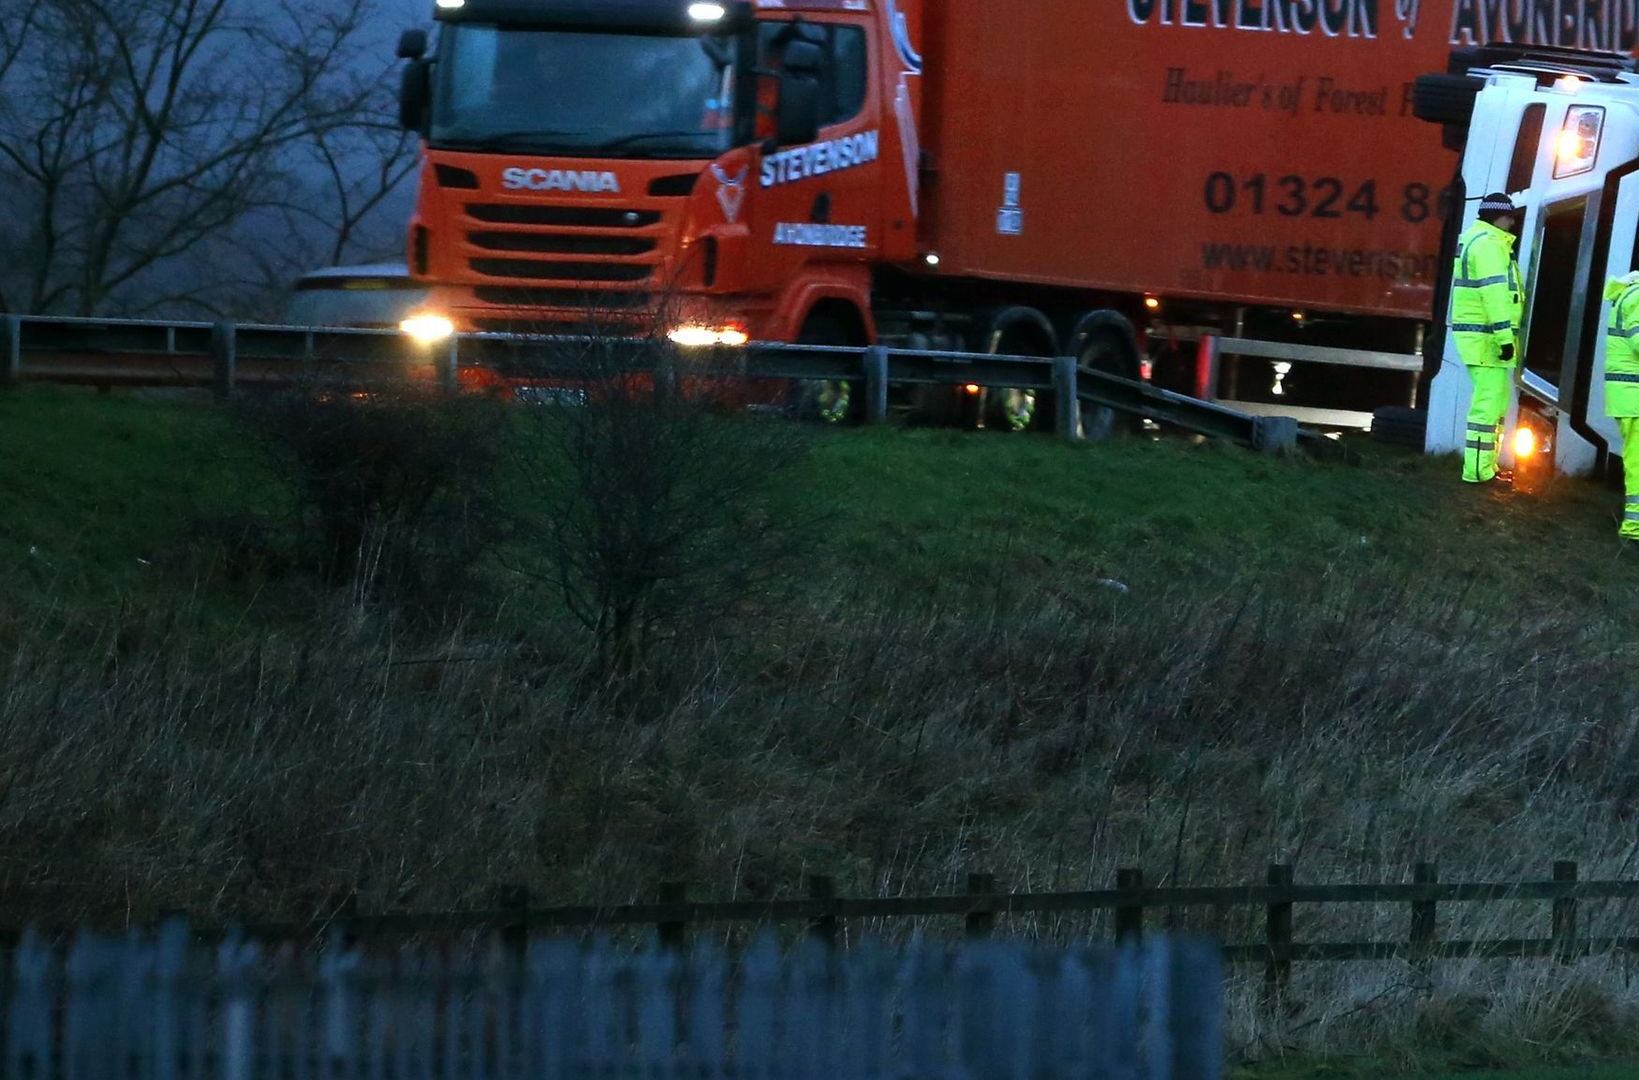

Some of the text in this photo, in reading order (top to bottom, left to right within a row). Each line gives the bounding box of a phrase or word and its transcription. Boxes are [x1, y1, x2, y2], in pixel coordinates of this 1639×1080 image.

[1314, 75, 1388, 117] Forest
[502, 167, 621, 193] SCANIA
[759, 129, 879, 188] STEVENSON
[1203, 171, 1380, 221] 01324
